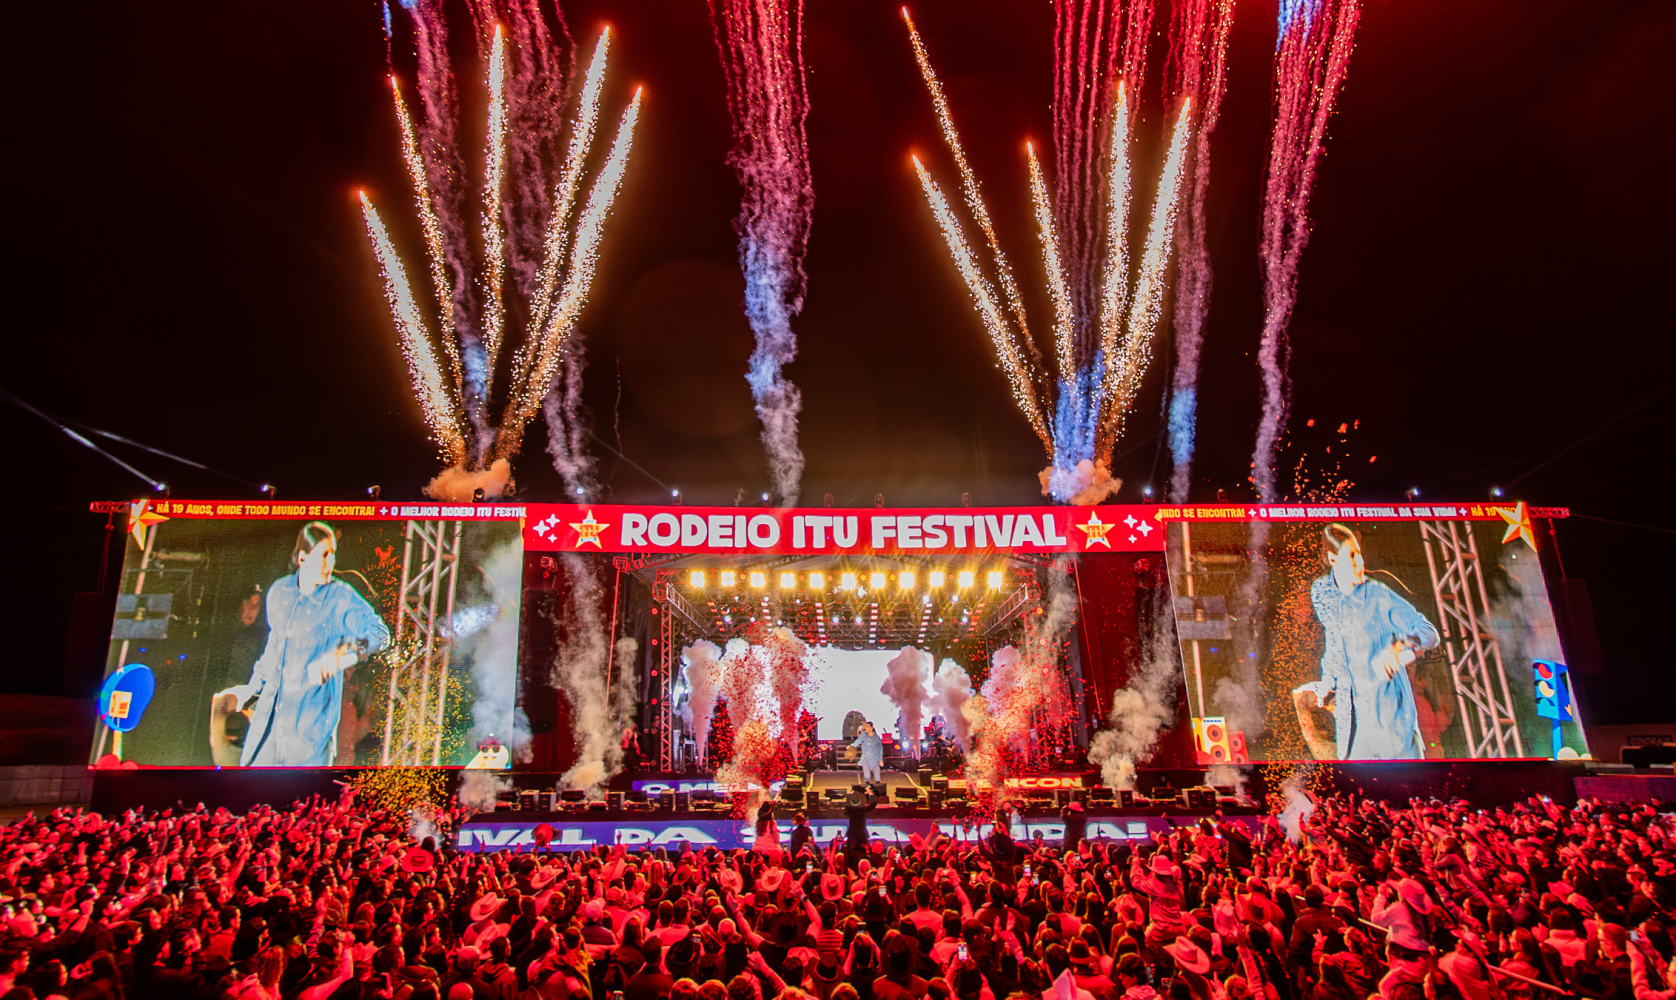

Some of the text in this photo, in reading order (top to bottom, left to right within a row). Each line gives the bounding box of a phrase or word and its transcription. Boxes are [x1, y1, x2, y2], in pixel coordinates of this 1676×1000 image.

[156, 501, 169, 514] HÁ
[172, 503, 184, 514] 19
[186, 504, 214, 516] ANOS,
[217, 505, 242, 515] ONDE
[245, 505, 269, 515] TODO
[271, 505, 306, 516] MUNDO
[308, 505, 321, 516] SE
[323, 506, 375, 516] ENCONTRA!
[390, 506, 398, 516] O
[400, 506, 439, 517] MELHOR
[441, 506, 475, 517] RODEIO
[476, 507, 492, 517] ITU
[1182, 507, 1195, 518] SE
[1197, 508, 1246, 518] ENCONTRA!
[1259, 508, 1267, 518] O
[1268, 507, 1305, 518] MELHOR
[1307, 507, 1339, 518] RODEIO
[1340, 507, 1355, 517] ITU
[1356, 507, 1398, 517] FESTIVAL
[1398, 507, 1413, 517] DA
[1413, 507, 1432, 517] SUA
[1432, 506, 1457, 517] VIDA!
[1470, 504, 1484, 517] HÁ
[1485, 506, 1497, 517] 19
[621, 513, 1066, 548] RODEIO ITU FESTIVAL
[615, 827, 718, 844] DA
